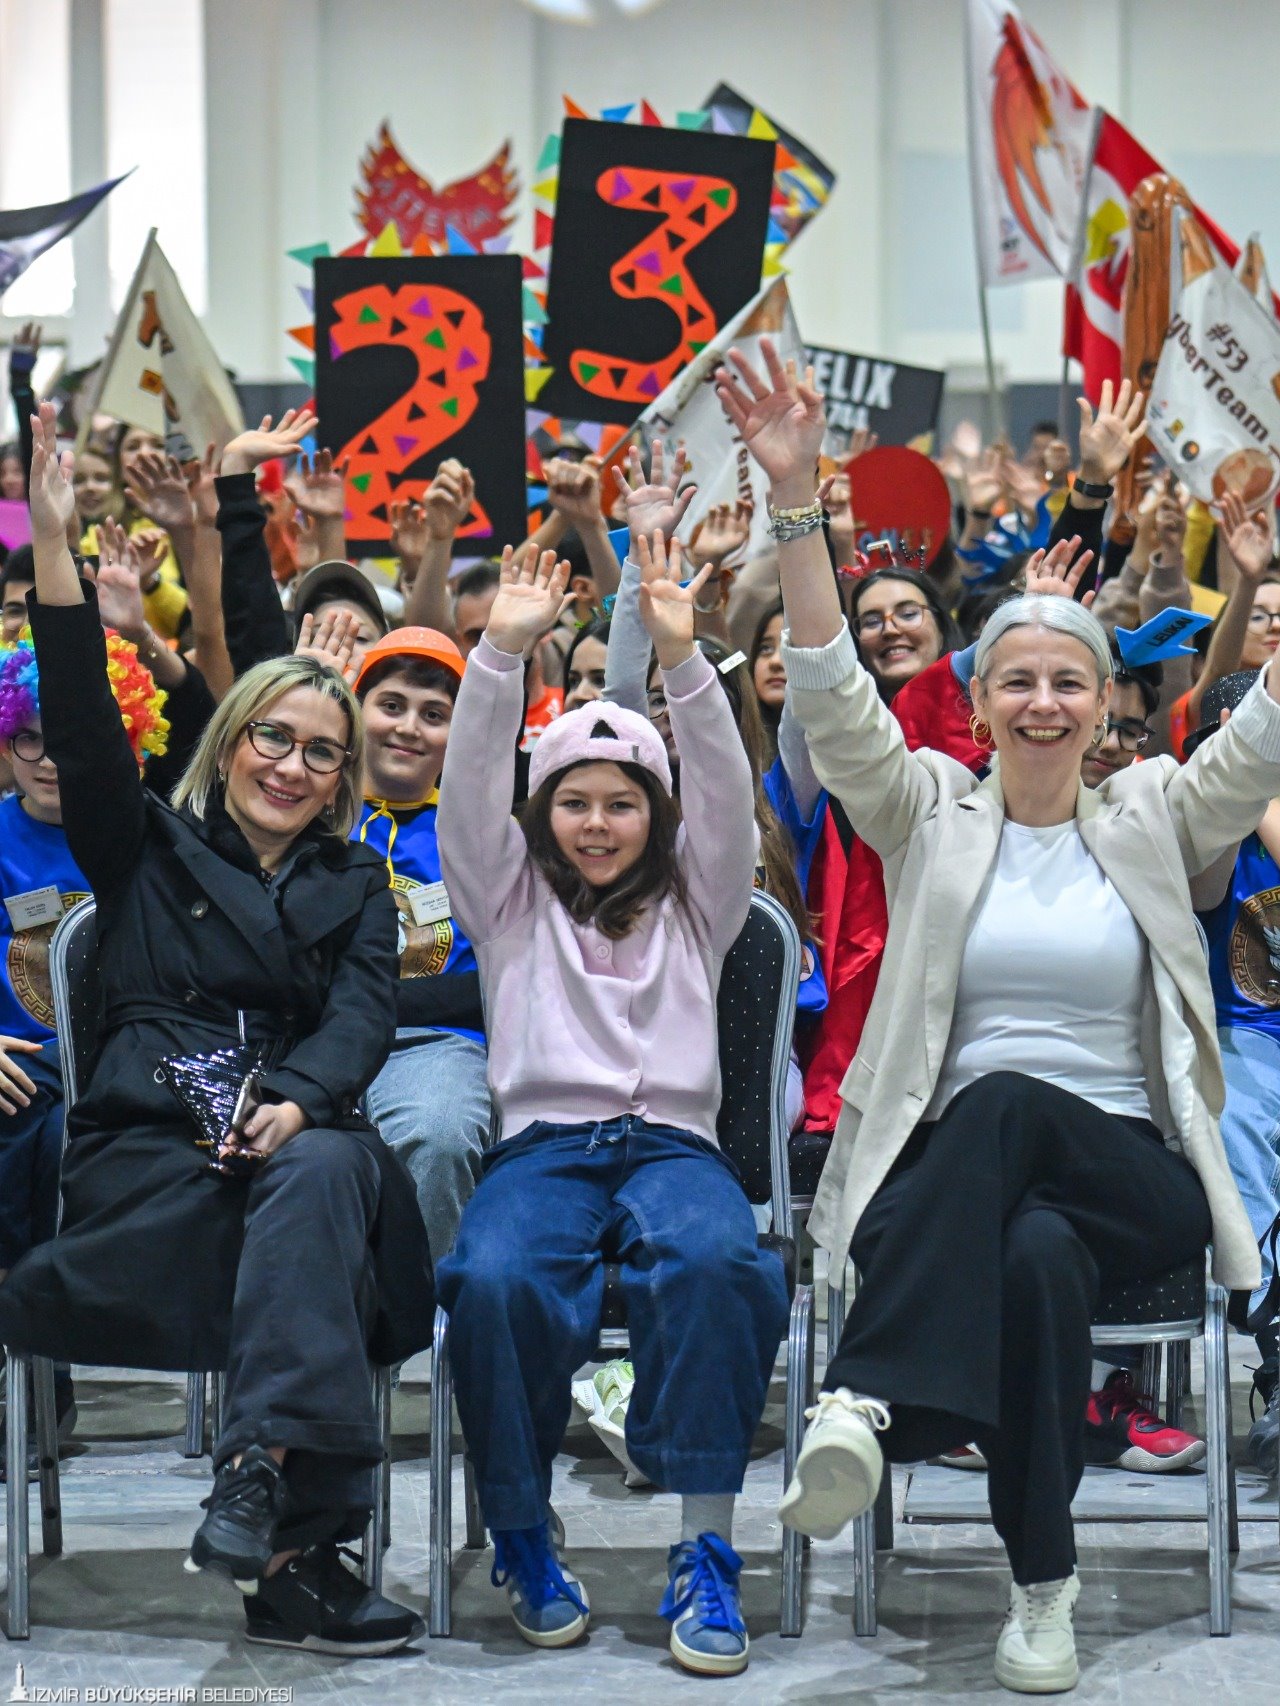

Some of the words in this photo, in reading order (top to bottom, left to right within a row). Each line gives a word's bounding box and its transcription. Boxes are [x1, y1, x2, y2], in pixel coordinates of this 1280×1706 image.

[570, 166, 737, 404] 3
[1206, 322, 1249, 374] #53
[330, 283, 494, 540] 2
